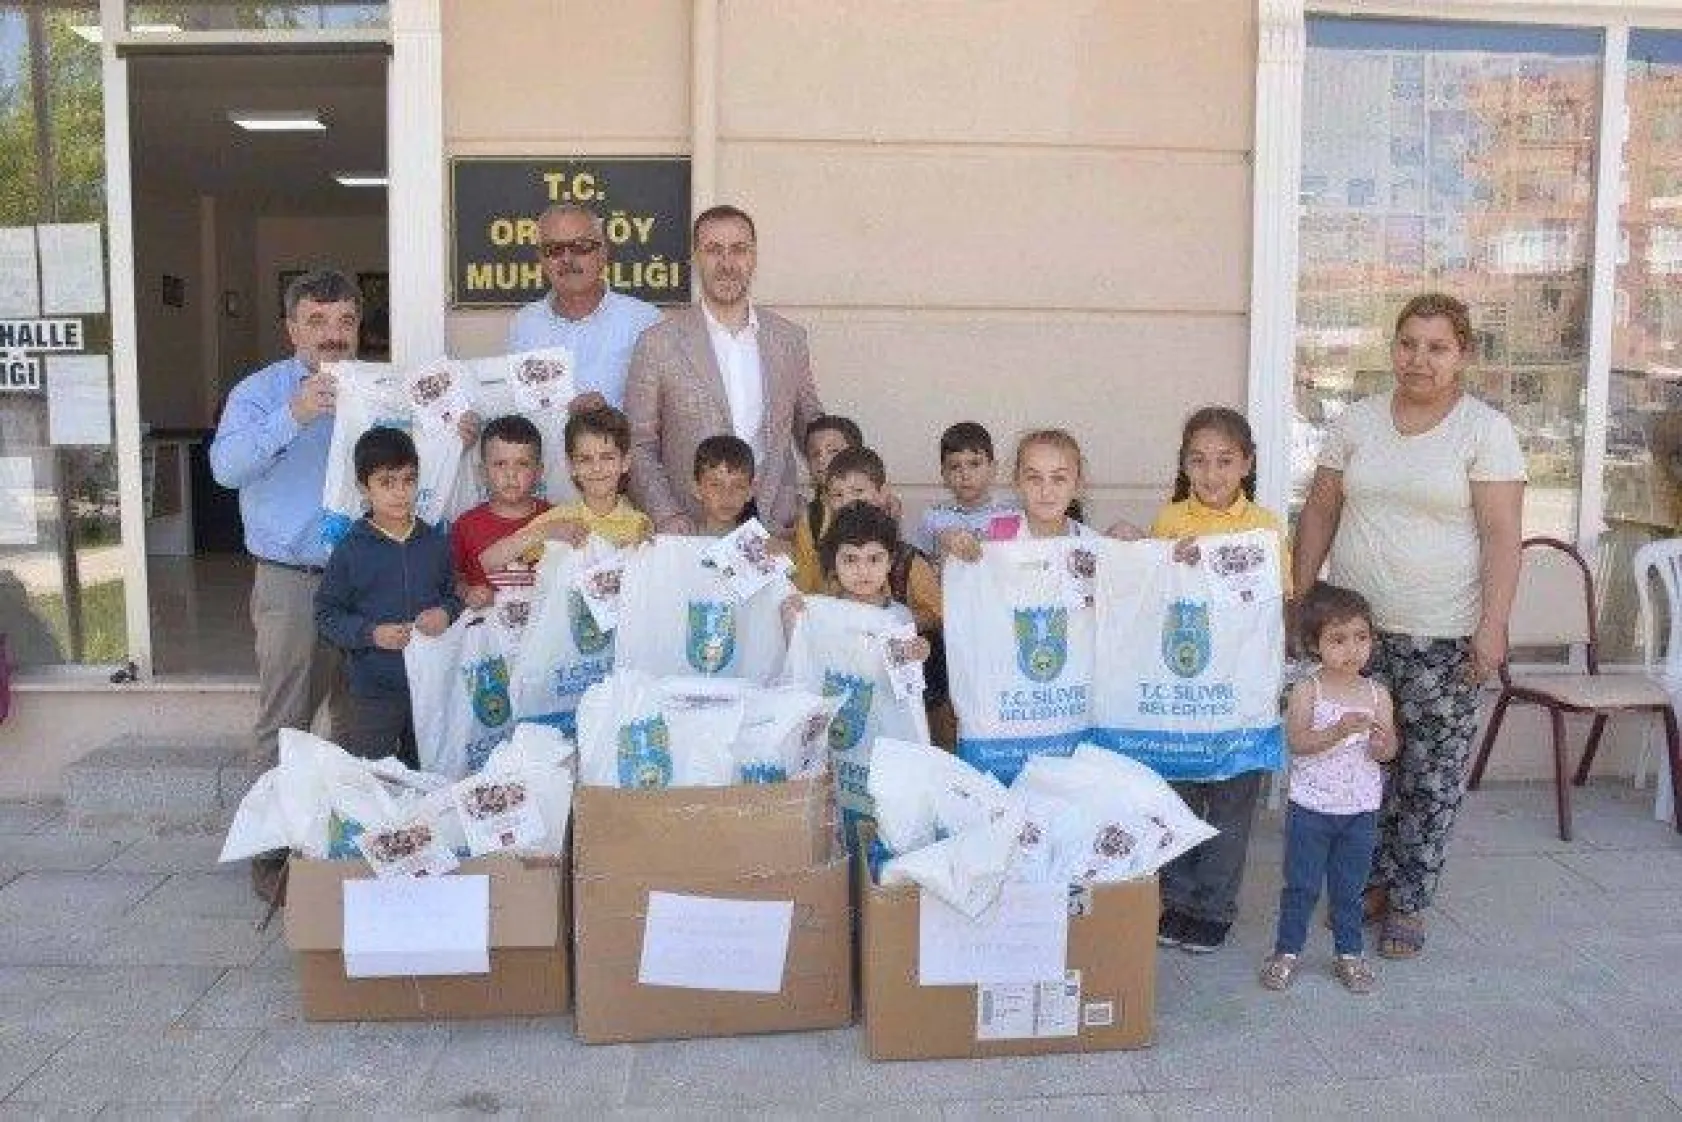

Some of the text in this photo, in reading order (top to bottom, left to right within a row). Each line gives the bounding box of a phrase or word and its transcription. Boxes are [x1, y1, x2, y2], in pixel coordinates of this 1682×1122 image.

[543, 172, 605, 201] T.C.
[490, 209, 656, 245] ORÖY
[467, 254, 679, 290] MUHLIĞI
[0, 322, 78, 347] HALLE
